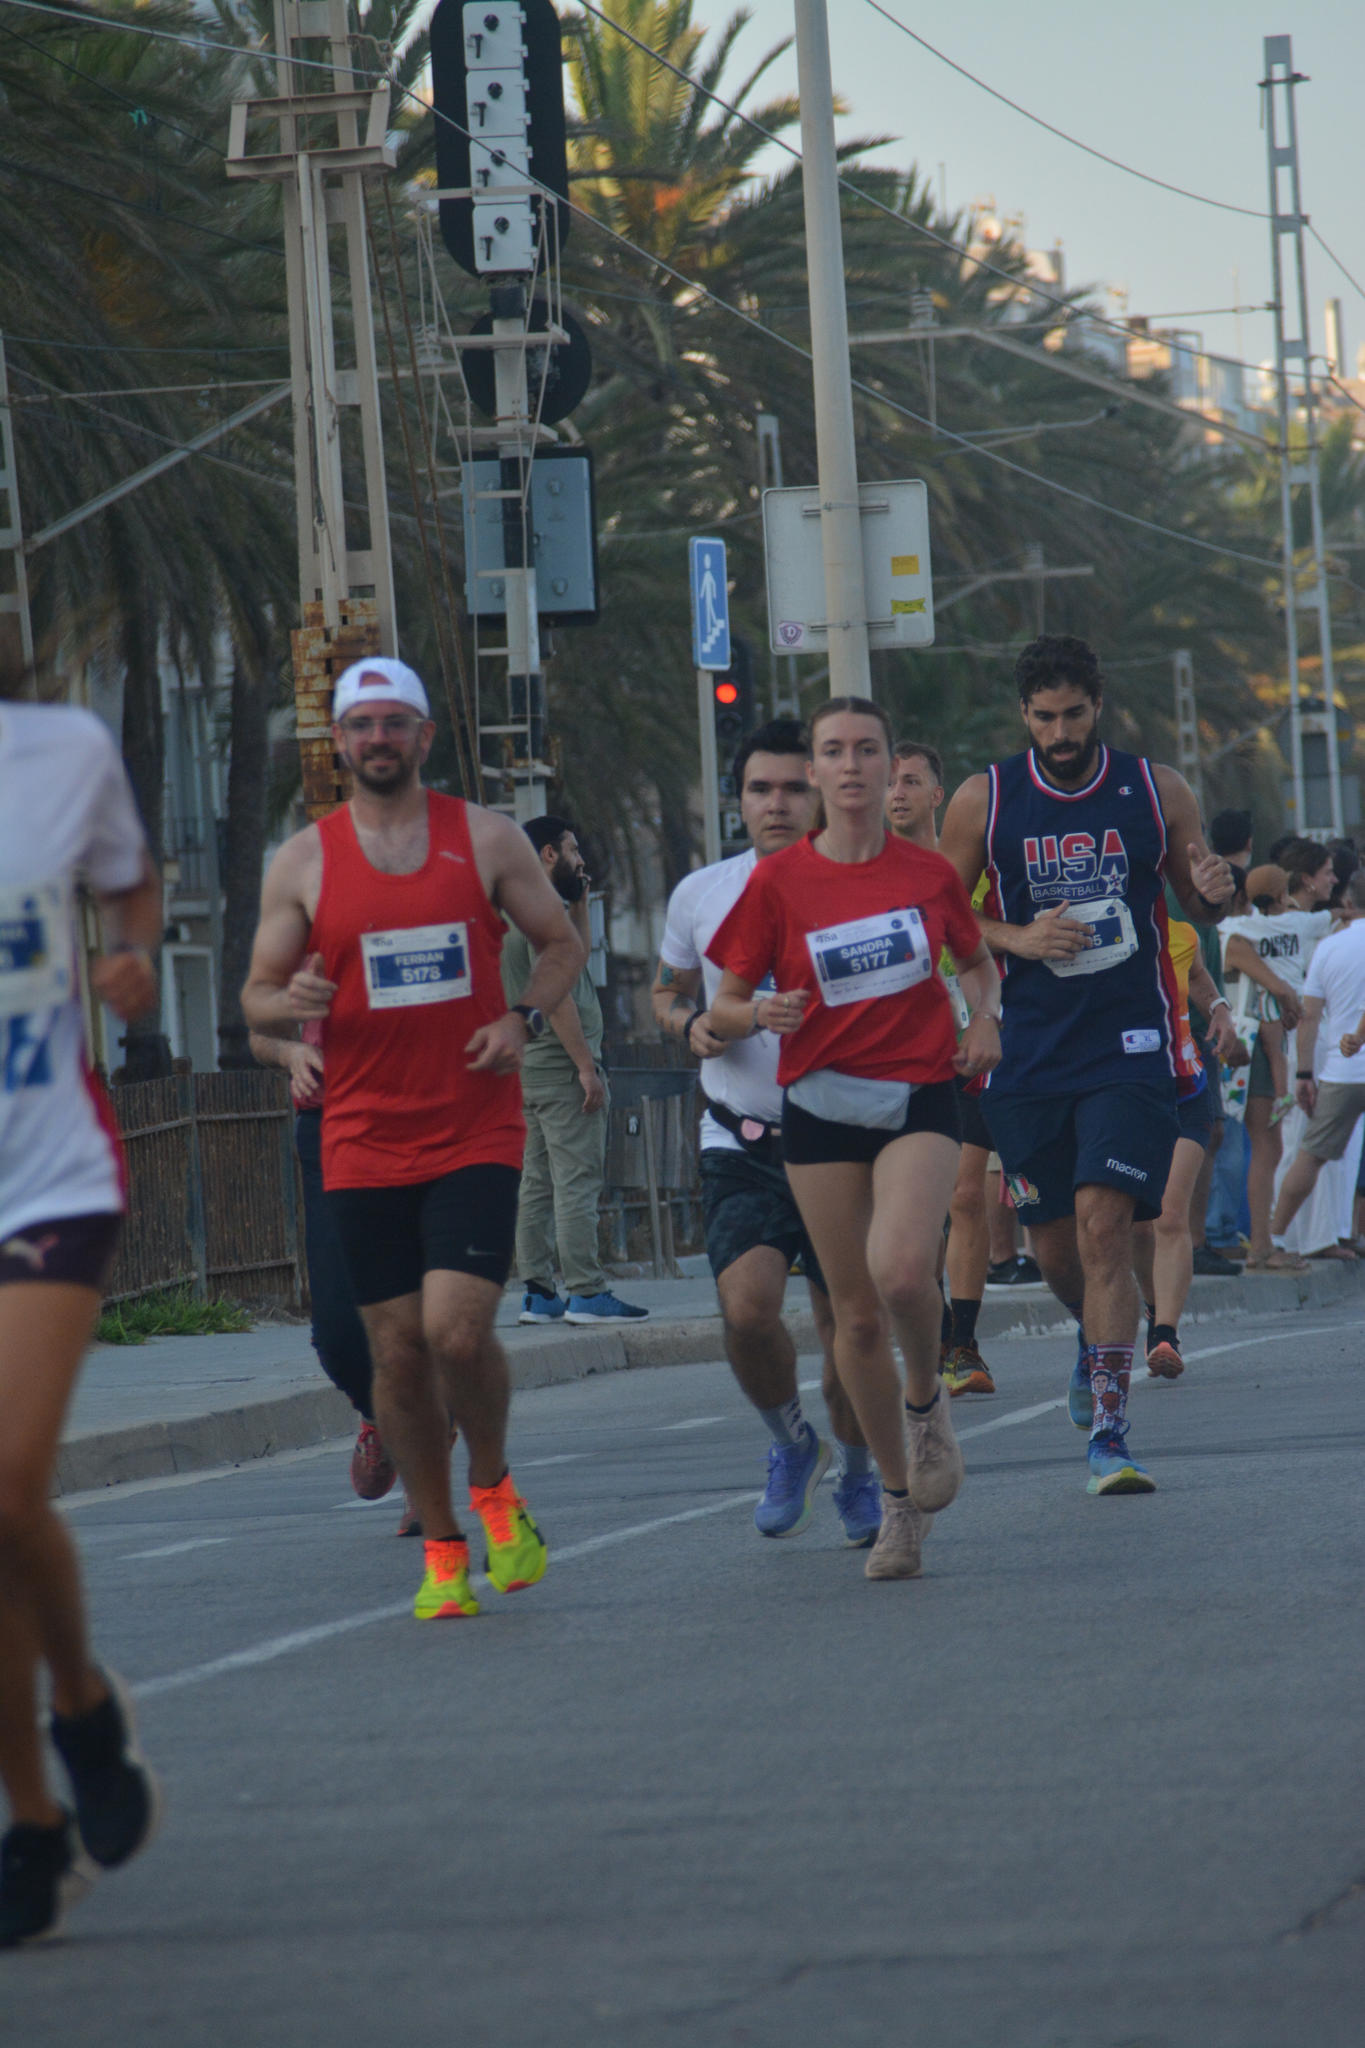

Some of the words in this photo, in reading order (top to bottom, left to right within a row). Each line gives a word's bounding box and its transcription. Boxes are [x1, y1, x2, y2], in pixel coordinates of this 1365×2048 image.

[1024, 829, 1129, 885] USA
[1034, 883, 1103, 898] BASKETBALL
[395, 951, 445, 967] FERRAN
[840, 937, 894, 959] SANDRA
[850, 950, 890, 972] 5177
[402, 965, 441, 983] 5178
[1106, 1158, 1148, 1182] macron
